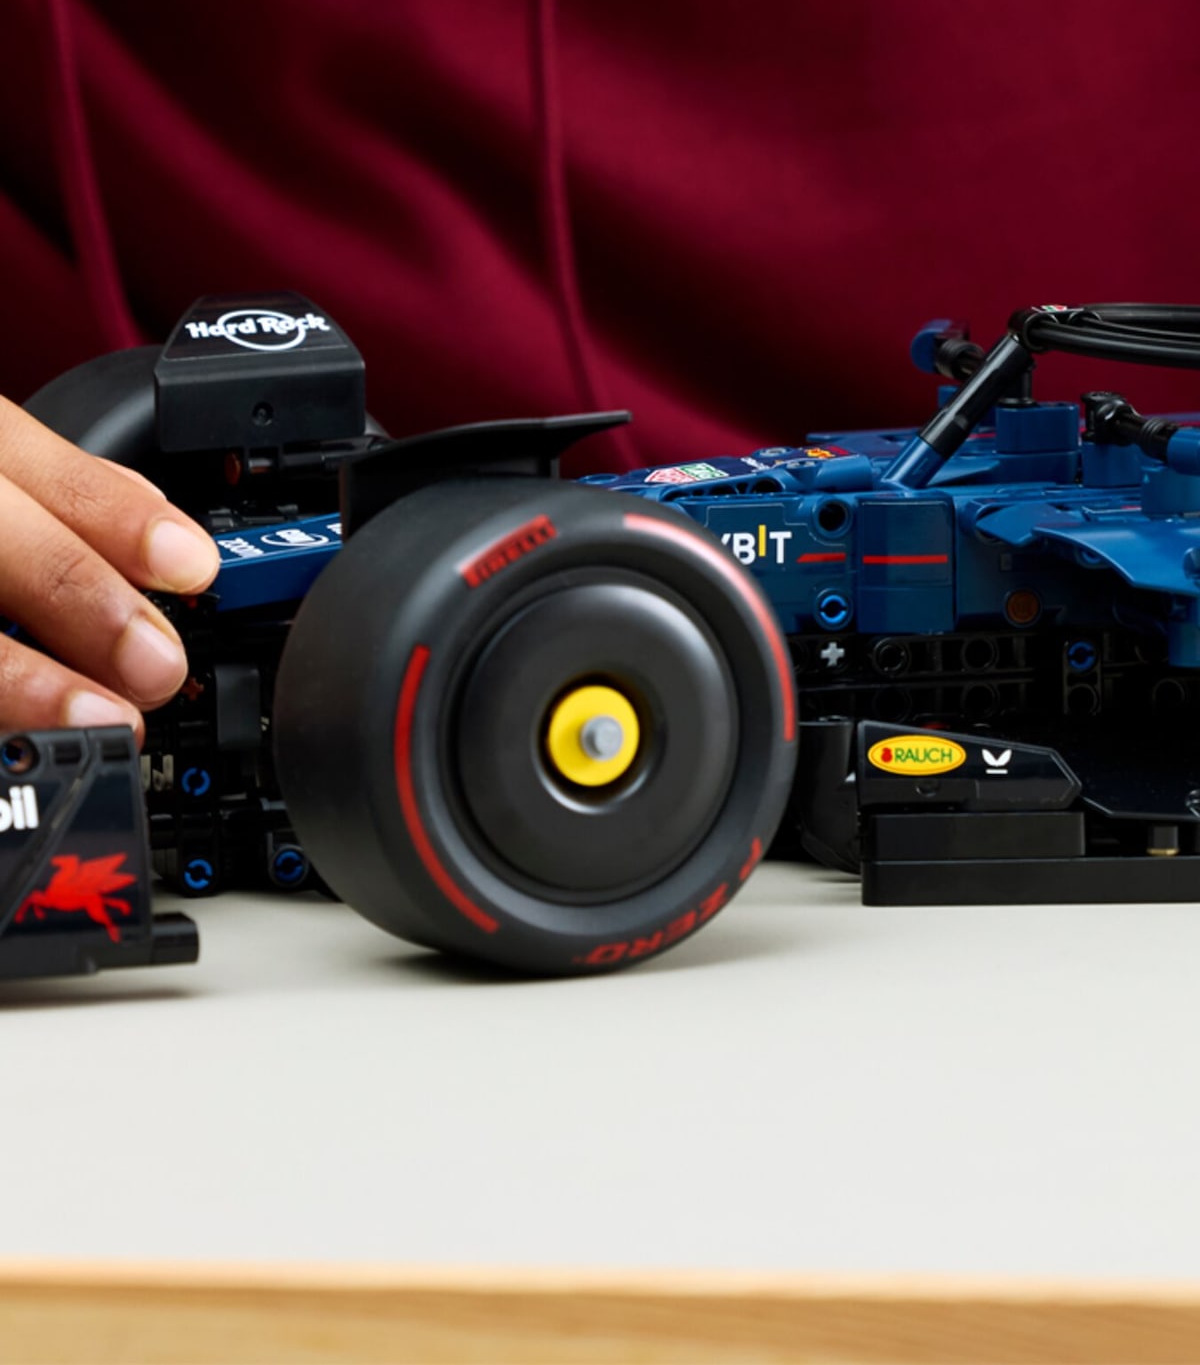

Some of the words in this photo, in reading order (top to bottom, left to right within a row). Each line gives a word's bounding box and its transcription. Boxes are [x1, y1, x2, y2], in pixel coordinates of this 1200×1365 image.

[184, 317, 257, 339] Hard
[257, 312, 331, 335] Rock
[894, 747, 953, 764] RAUCH
